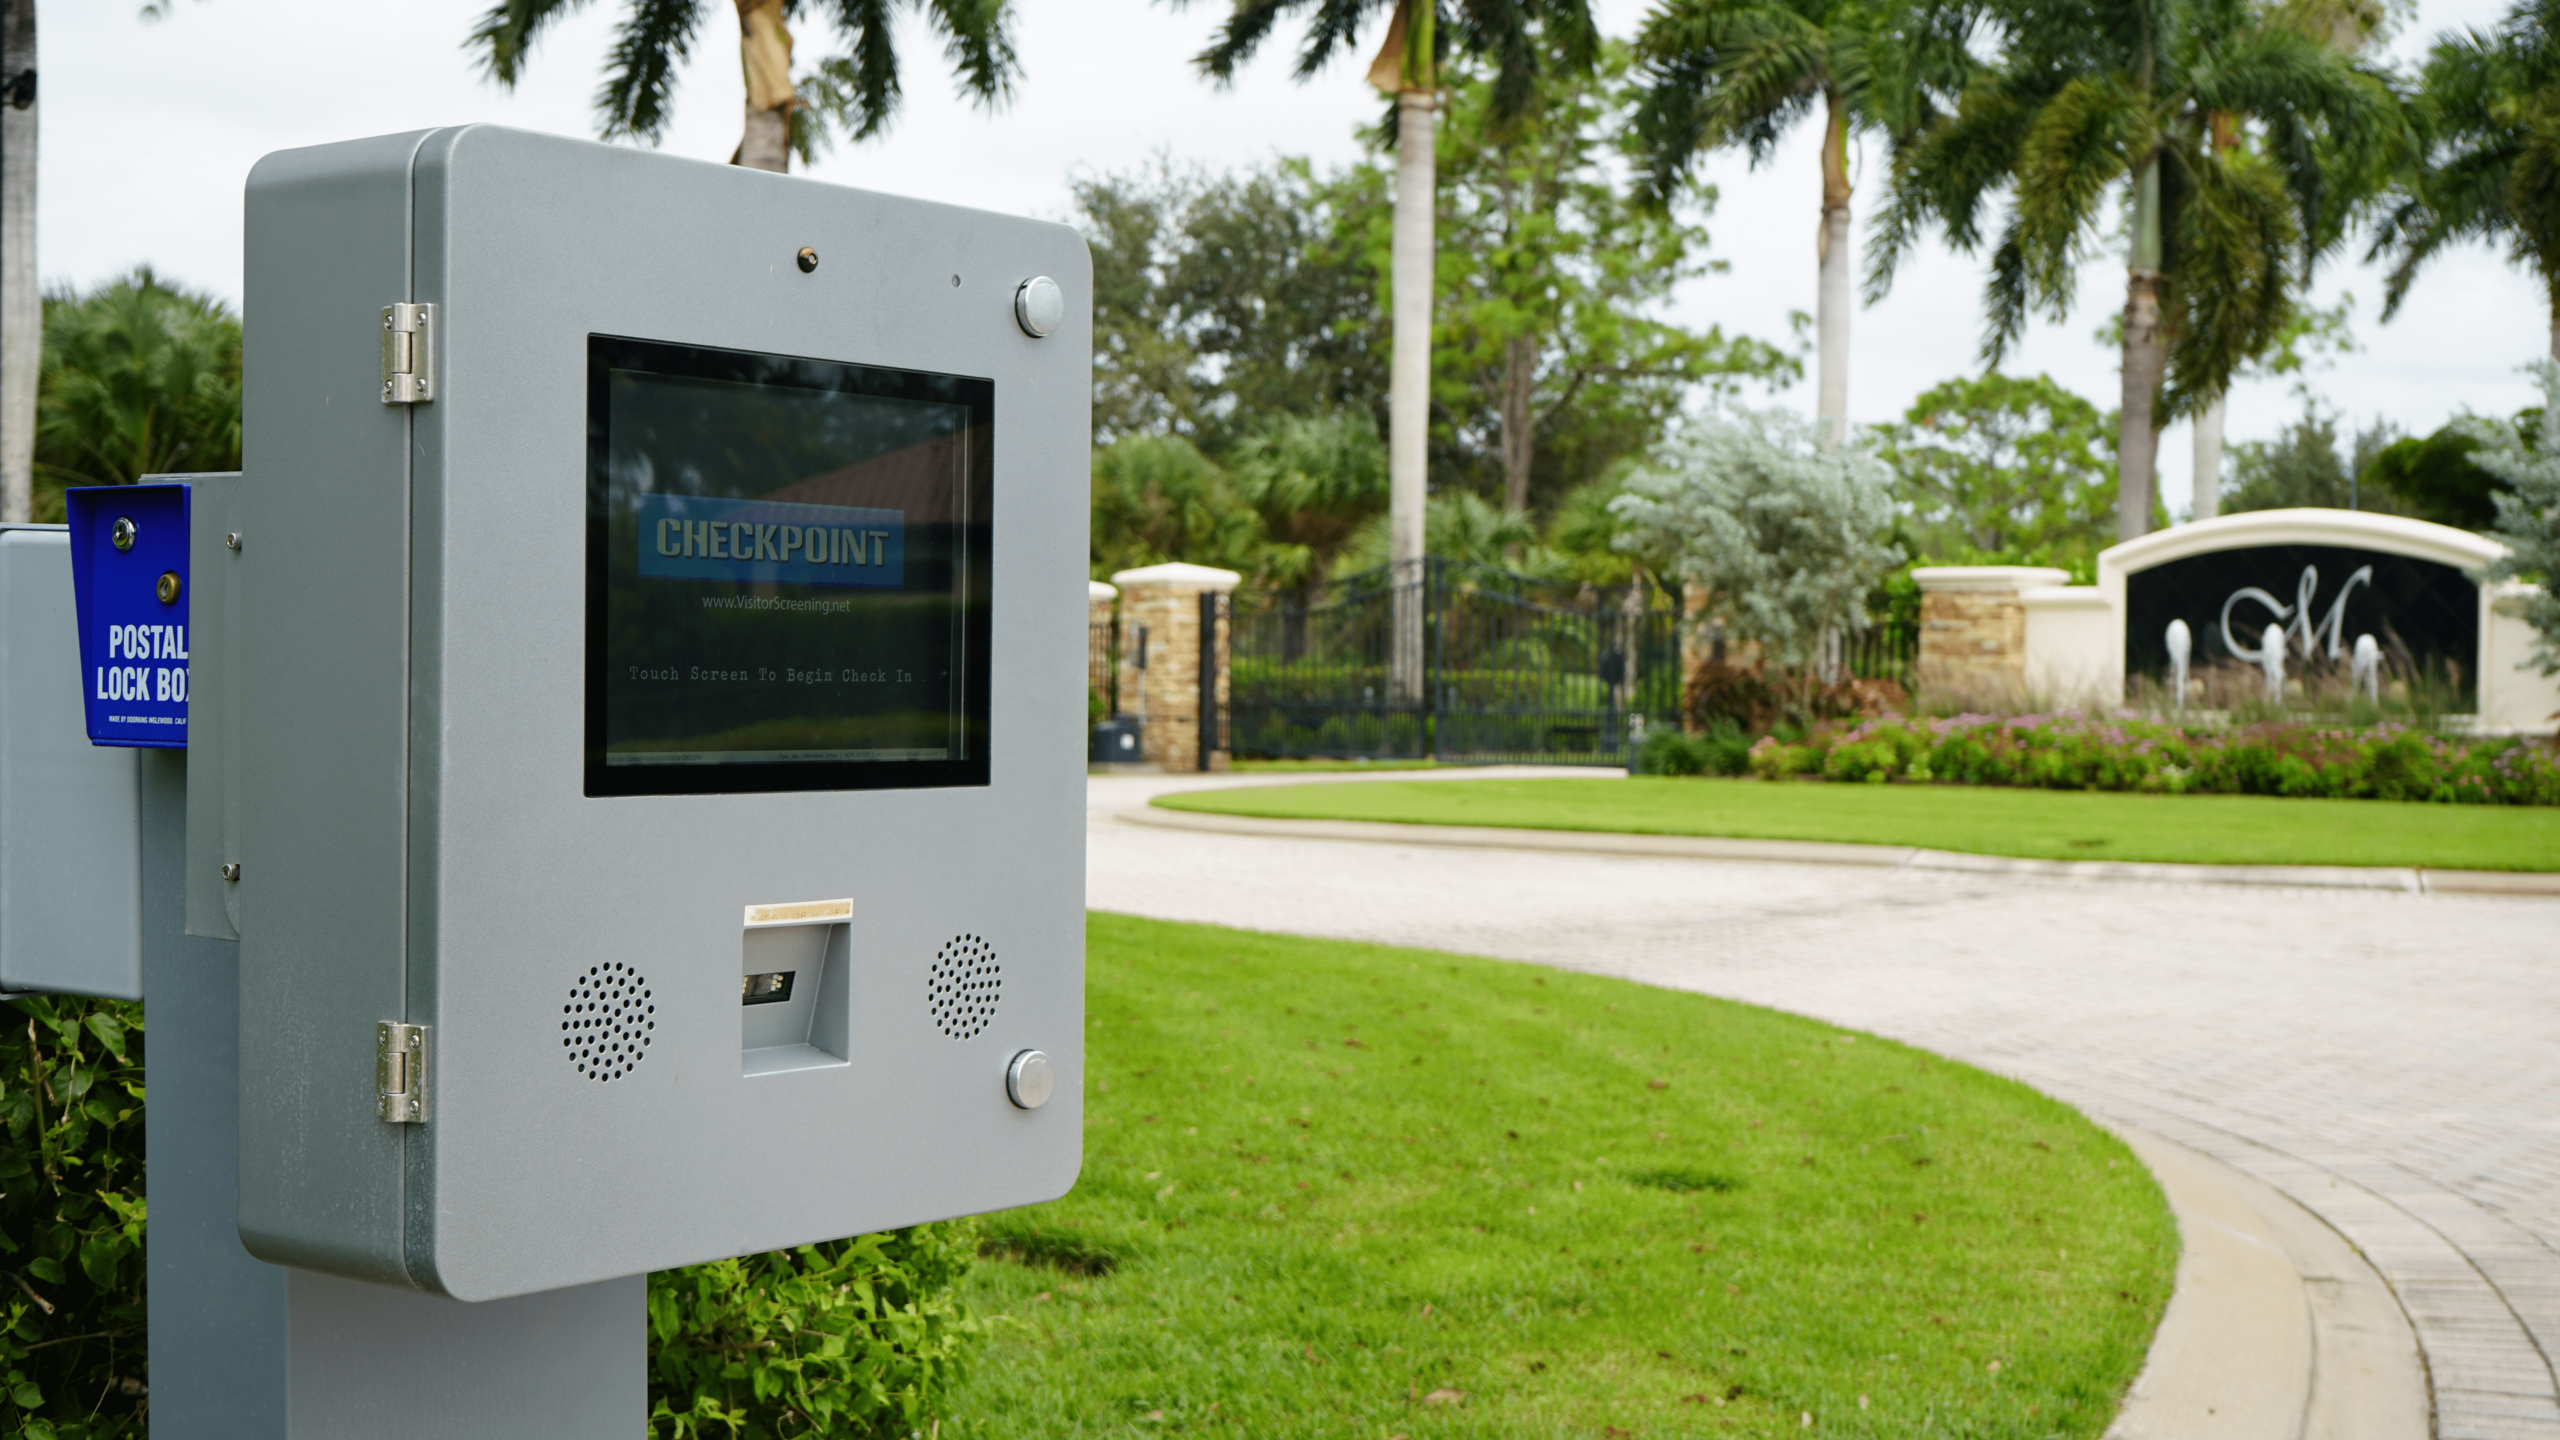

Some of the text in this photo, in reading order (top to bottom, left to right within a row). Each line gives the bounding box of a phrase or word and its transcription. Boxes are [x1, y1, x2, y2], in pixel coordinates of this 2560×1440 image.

[656, 517, 890, 567] CHECKPOINT
[702, 594, 851, 615] www.VisitorScreening.net
[109, 624, 188, 659] POSTAL
[97, 666, 189, 702] LOCK BO
[629, 665, 912, 685] Touch Screen To Begin Check In
[108, 715, 120, 723] MADE
[120, 715, 127, 723] BY
